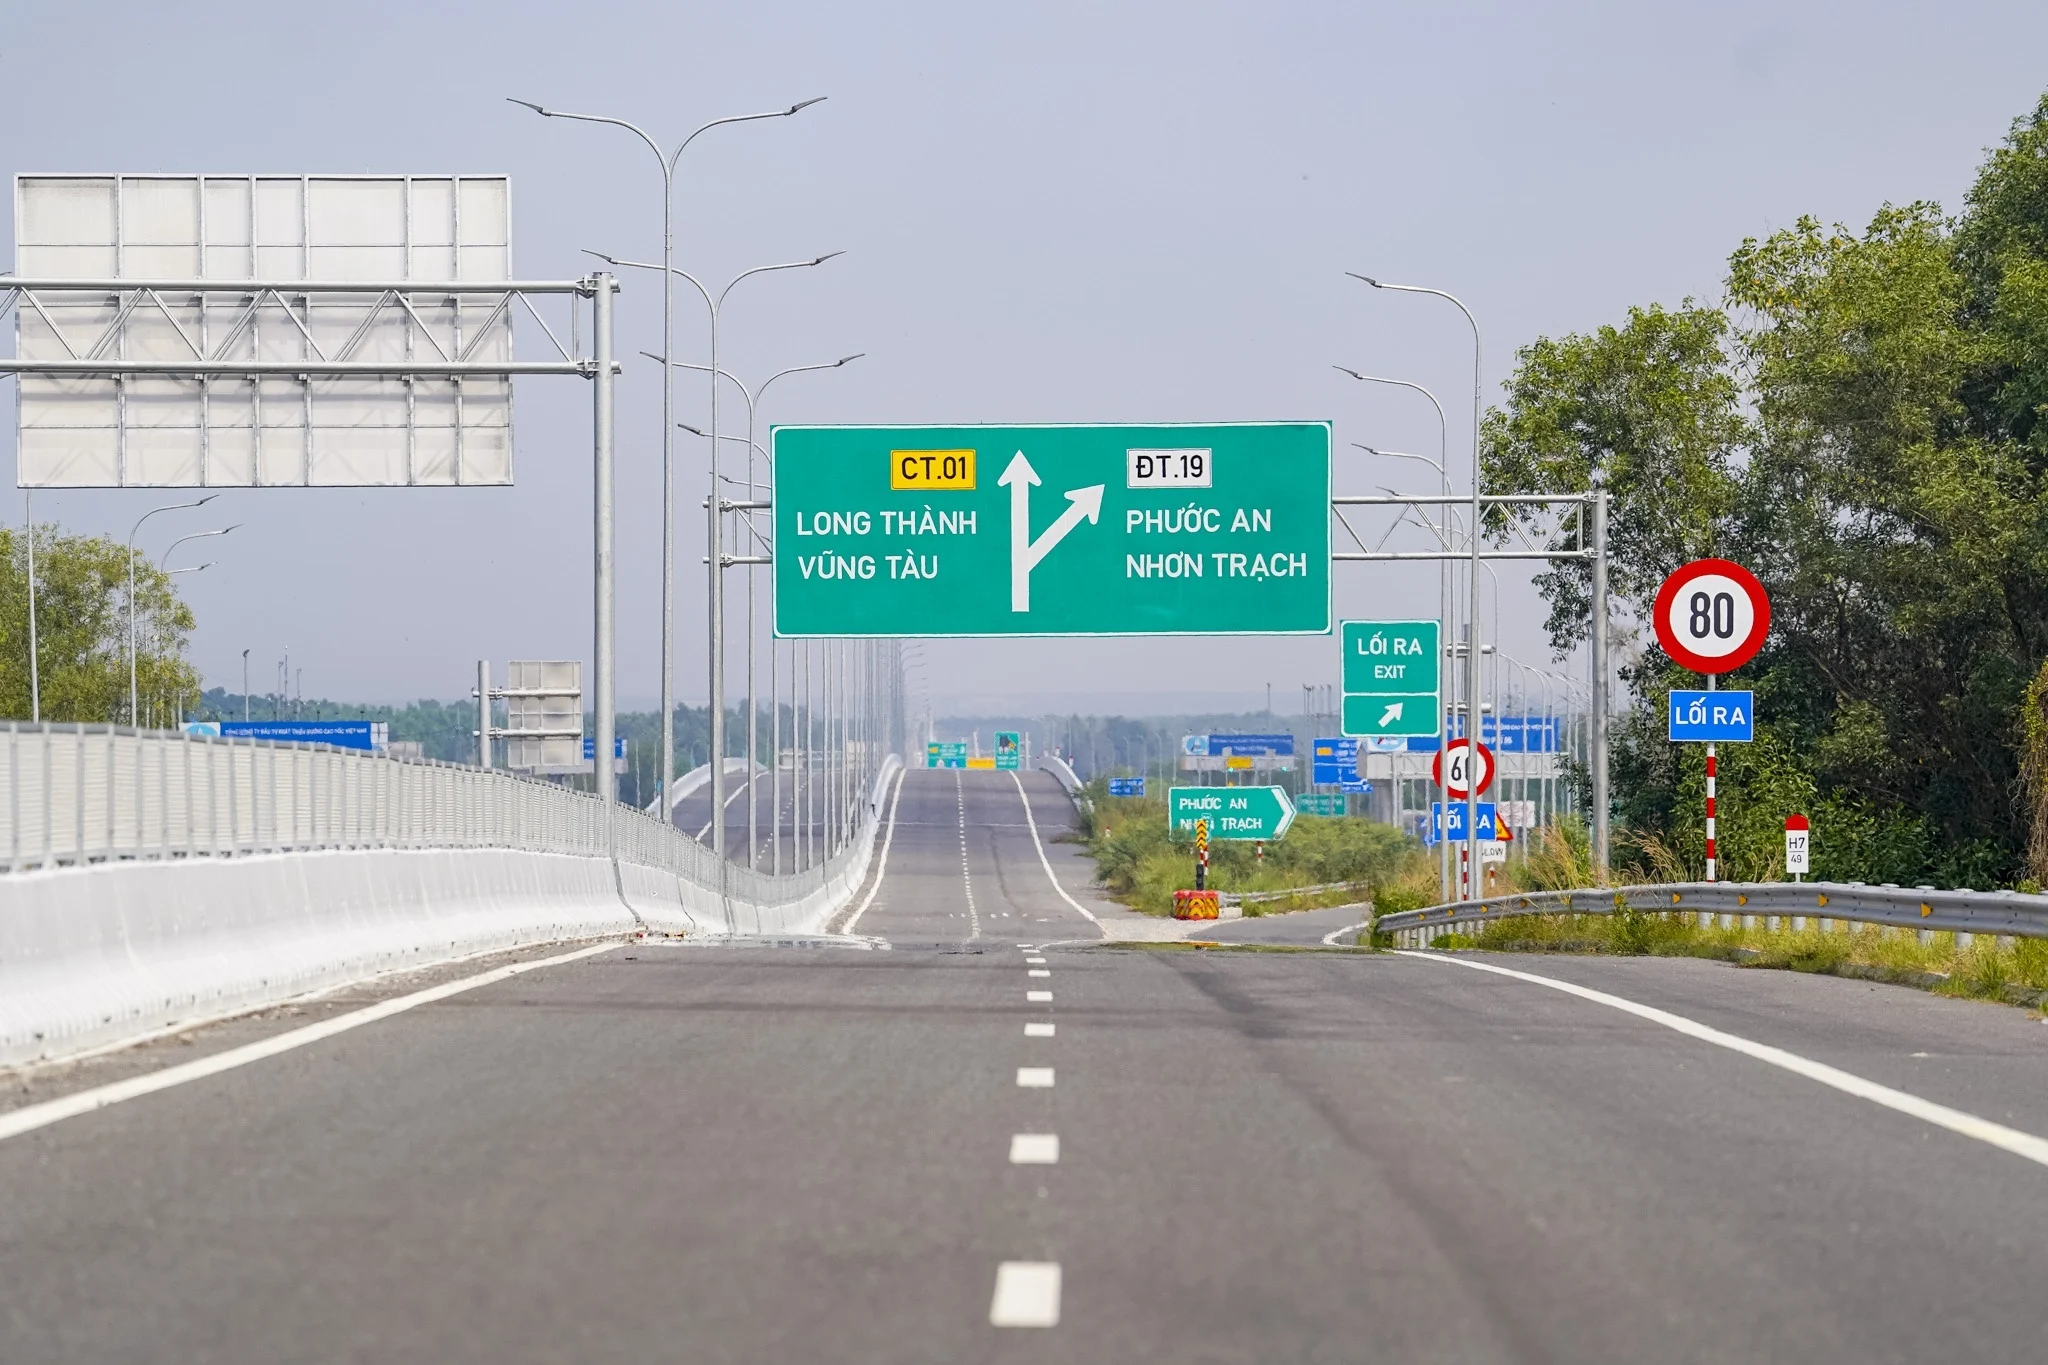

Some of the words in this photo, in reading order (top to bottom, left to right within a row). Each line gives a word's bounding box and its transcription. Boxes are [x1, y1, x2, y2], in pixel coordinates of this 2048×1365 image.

[901, 456, 966, 480] CT.01
[1135, 454, 1203, 479] ĐT.19
[797, 510, 871, 536] LONG
[879, 504, 977, 535] THÀNH
[1126, 502, 1221, 534] PHƯỚC
[1230, 508, 1271, 533] AN
[797, 549, 876, 580] VŨNG
[885, 549, 938, 580] TÀU
[1126, 551, 1203, 578] NHƠN
[1211, 552, 1307, 582] TRẠCH
[1689, 591, 1734, 639] 80
[1357, 631, 1388, 655] LỐI
[1393, 637, 1423, 655] RA
[1374, 664, 1406, 679] EXIT
[1675, 696, 1707, 725] LỐI
[1713, 706, 1746, 725] RA
[1229, 797, 1247, 810] AN
[1220, 817, 1263, 832] TRẠCH
[1789, 837, 1806, 849] H7
[1791, 854, 1802, 864] 49
